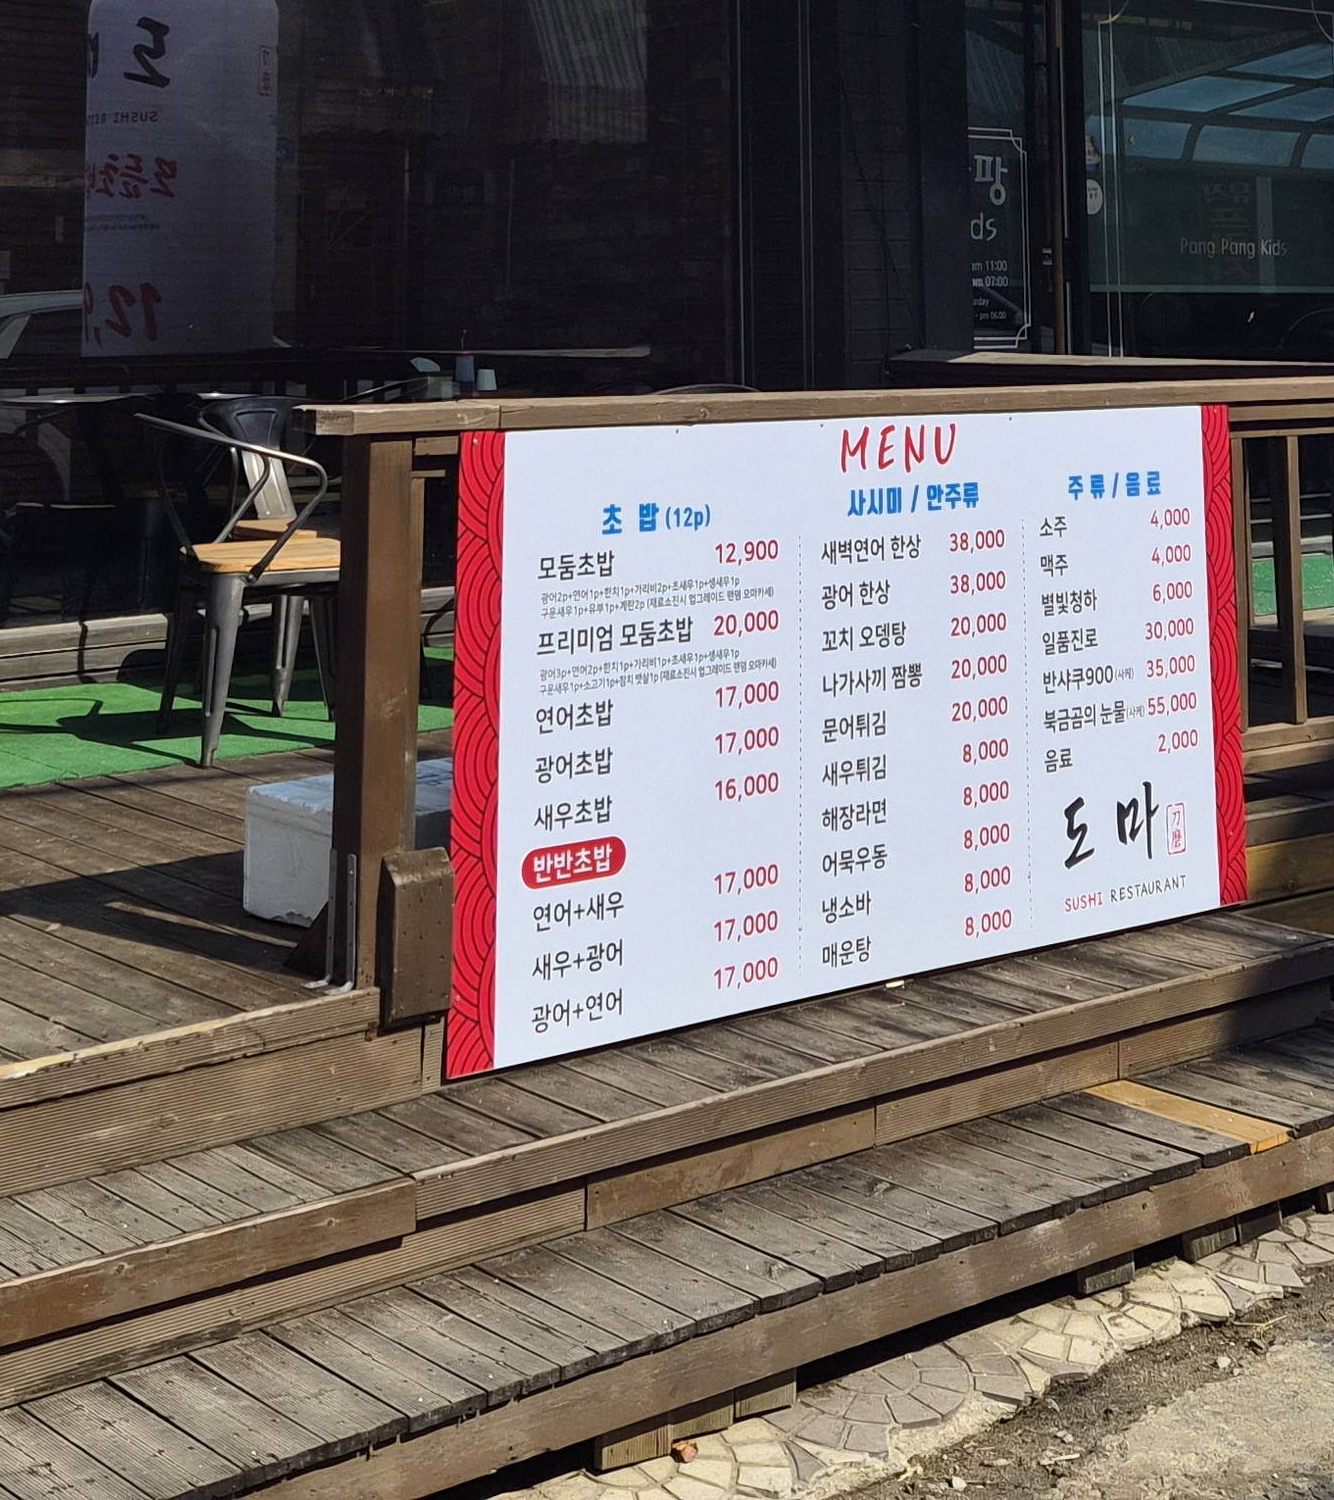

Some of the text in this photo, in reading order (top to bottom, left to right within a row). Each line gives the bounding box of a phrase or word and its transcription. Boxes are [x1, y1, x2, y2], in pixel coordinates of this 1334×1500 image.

[969, 154, 1009, 206] 팡
[970, 212, 998, 242] ds
[1180, 237, 1288, 260] Pang Pang Kids
[840, 422, 957, 474] MENU
[1039, 507, 1191, 538] 소주 4,000
[537, 538, 779, 581] 모둠초밥 12,900
[821, 529, 1006, 566] 새벽연어 한상 38,000
[1040, 544, 1192, 578] 맥주 4,000
[821, 570, 1007, 611] 광어 한상 38,000
[1041, 580, 1193, 617] 별빛청하 6,000
[536, 609, 779, 656] 프리미엄 모둠초밥 20,000
[821, 612, 1007, 652] 꼬치 오뎅탕 20,000
[1042, 617, 1194, 656] 일품진로 30,000
[822, 654, 1008, 698] 나가사끼 짬뽕 20,000
[1146, 654, 1196, 679] 35,000
[535, 680, 779, 734] 연어초밥 17,000
[822, 696, 1009, 744] 문어튀김 20,000
[1147, 691, 1198, 716] 55,000
[534, 725, 779, 784] 광어초밥 17,000
[821, 738, 1009, 787] 새우튀김 8,000
[1044, 729, 1198, 773] 음료 2,000
[534, 771, 779, 832] 새우초밥 16,000
[821, 780, 1010, 832] 해장라면 8,000
[533, 843, 613, 883] 반반초밥
[822, 823, 1010, 877] 어묵우동 8,000
[532, 863, 779, 933] 연어+새우 17,000
[821, 865, 1011, 925] 냉소바 8,000
[1065, 874, 1187, 912] SUSHI RESTAURANT
[531, 910, 779, 981] 새우+광어 17,000
[822, 909, 1012, 968] 매운탕 8,000
[531, 956, 779, 1035] 광어+연어 17,000
